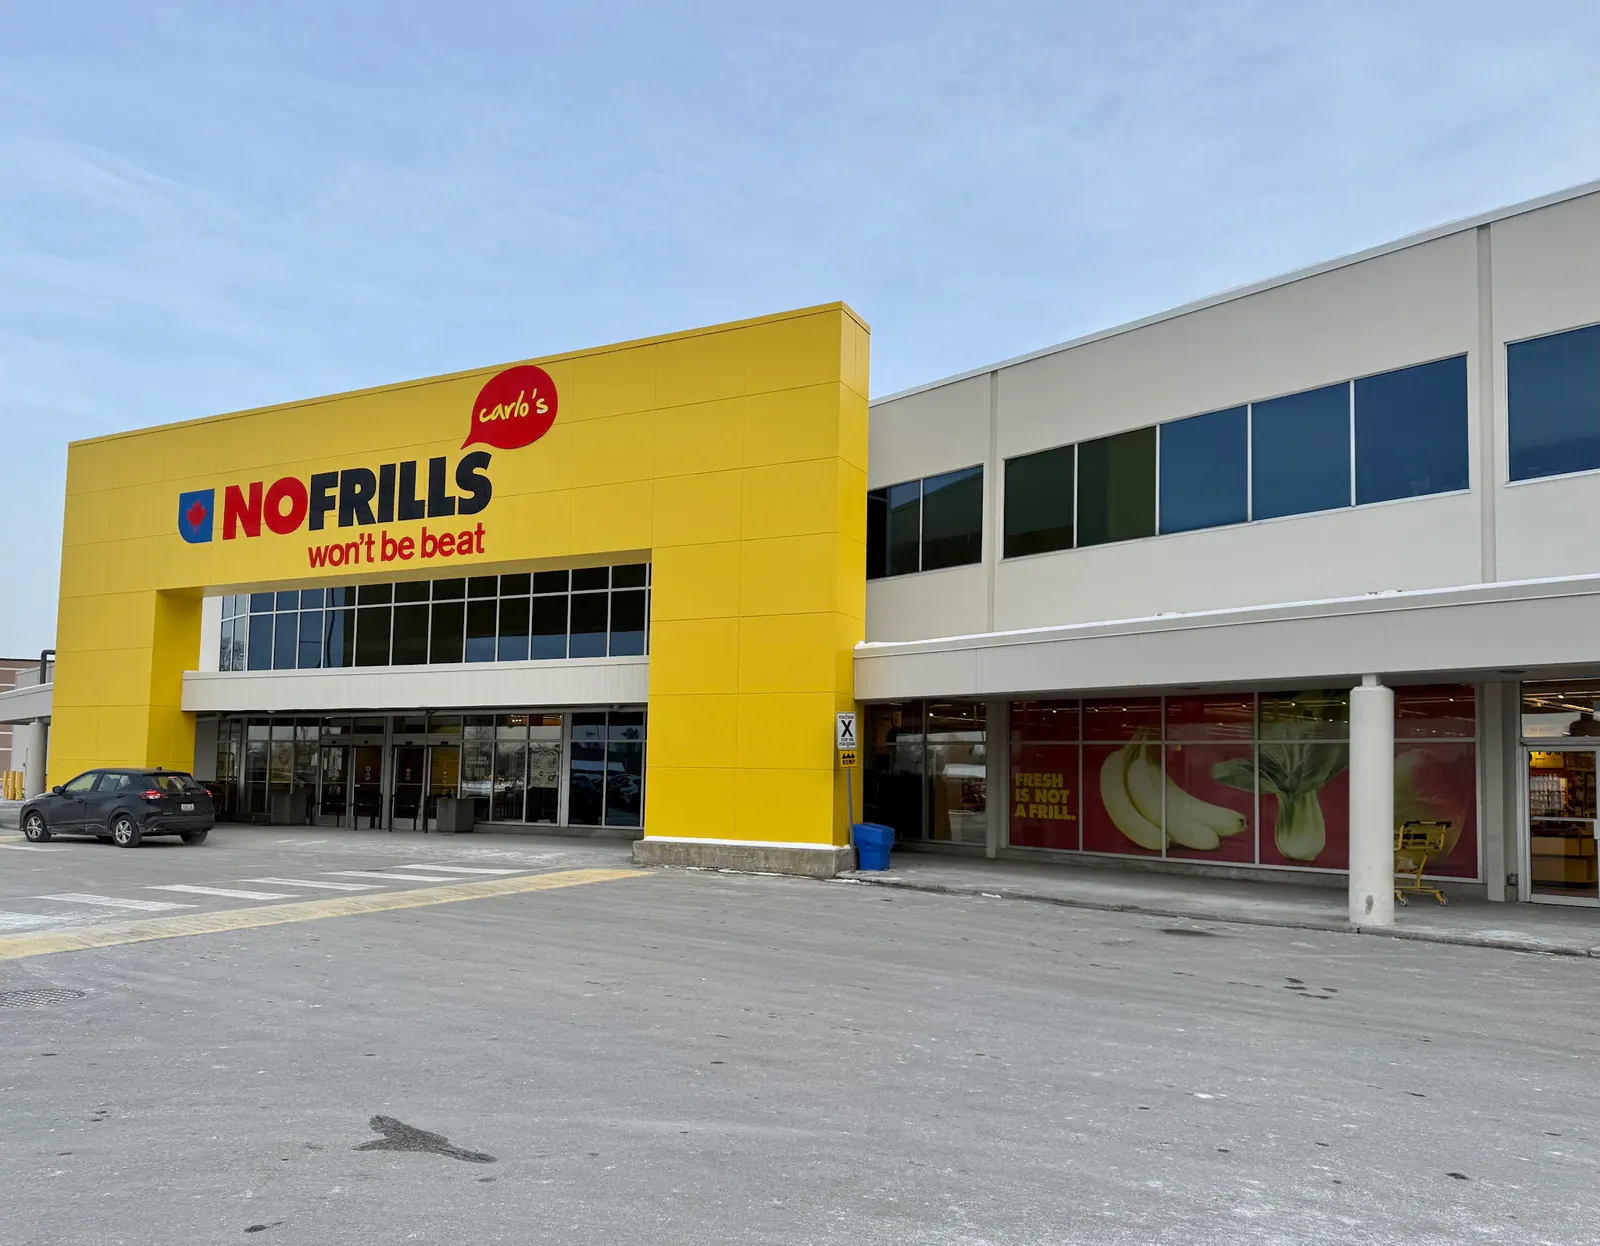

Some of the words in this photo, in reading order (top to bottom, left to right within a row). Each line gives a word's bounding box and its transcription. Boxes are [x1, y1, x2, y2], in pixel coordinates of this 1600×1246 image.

[479, 388, 549, 423] carlo's
[308, 533, 375, 568] won't
[381, 530, 415, 561] be
[421, 523, 487, 558] beat
[1015, 773, 1063, 787] FRESH
[1015, 788, 1029, 802] IS
[1035, 789, 1069, 803] NOT
[1014, 803, 1026, 817] A
[1029, 804, 1076, 820] FRILL.
